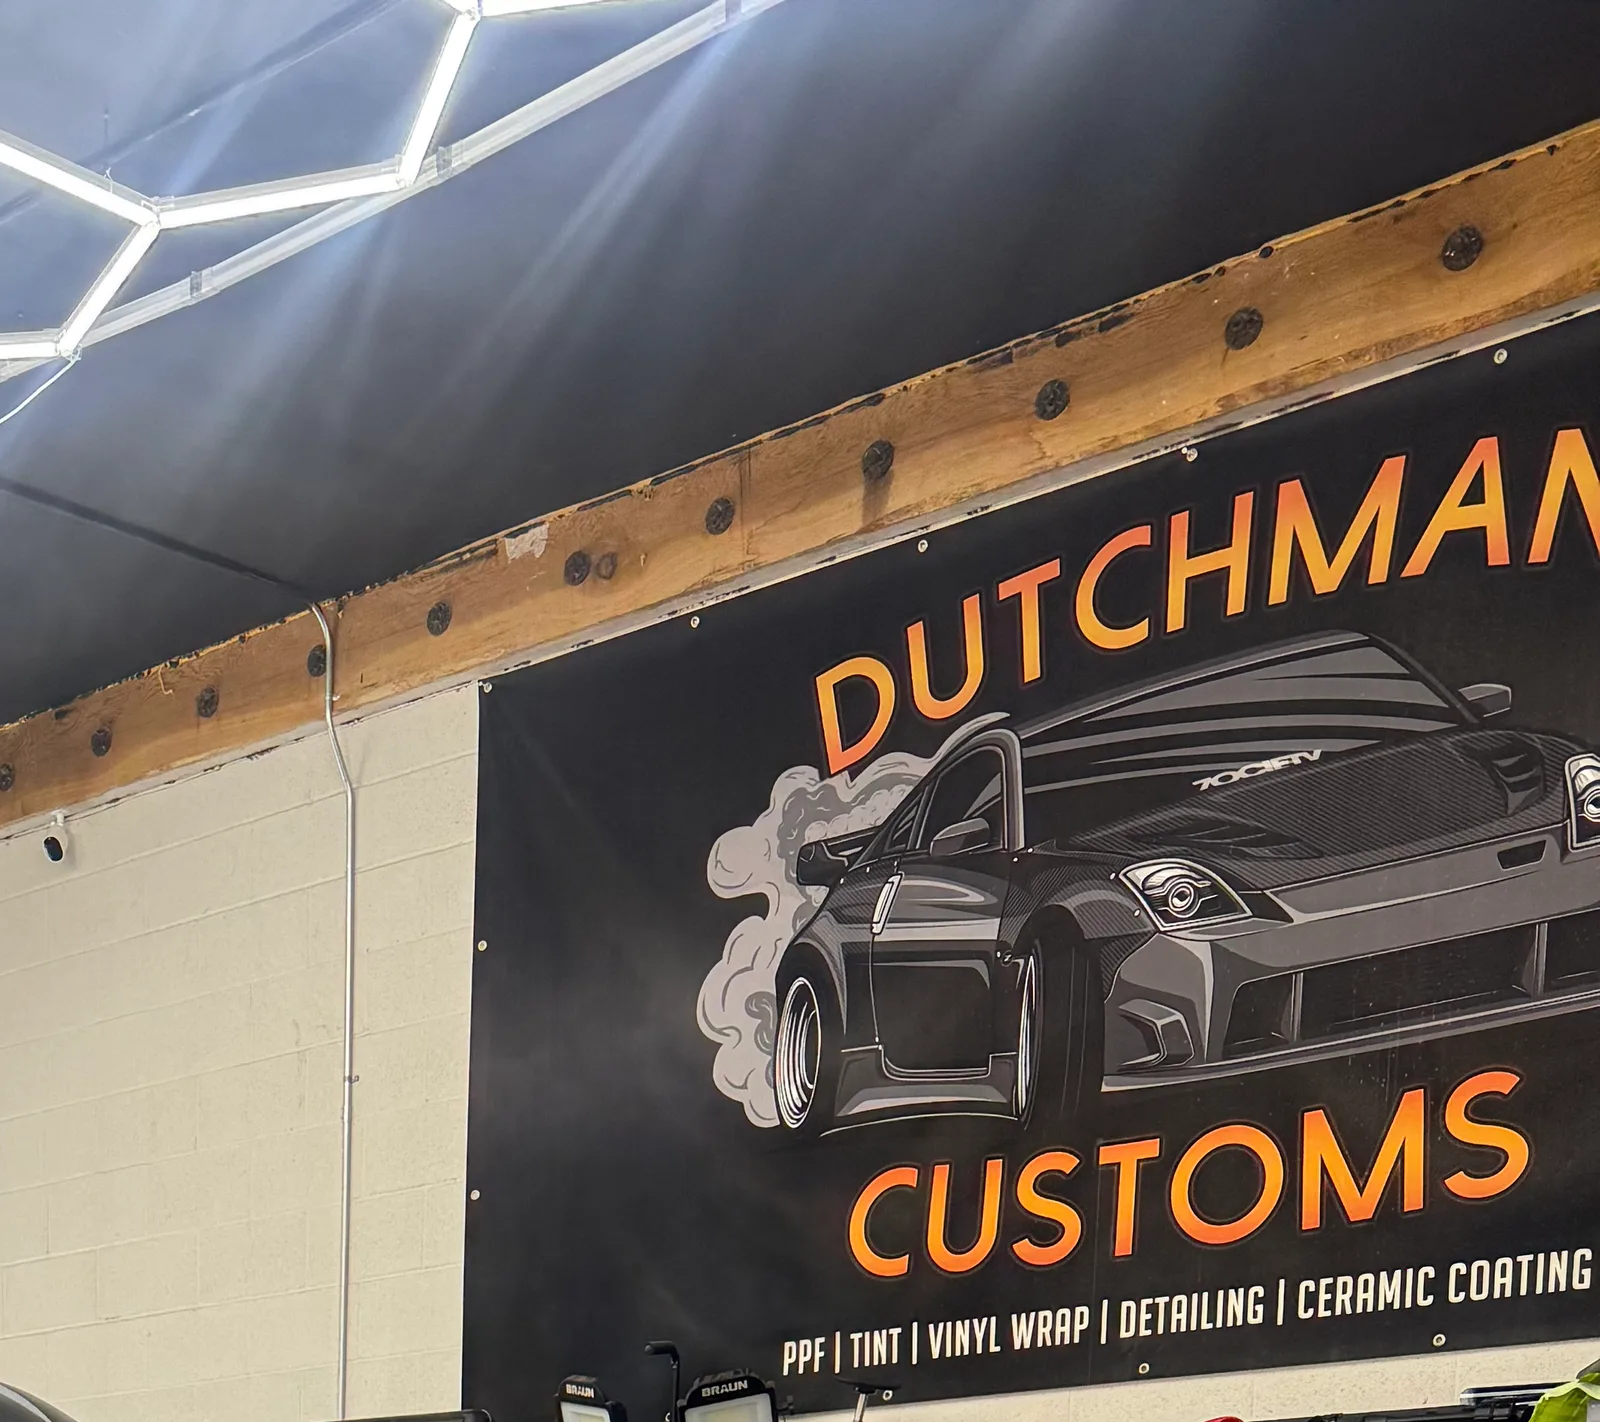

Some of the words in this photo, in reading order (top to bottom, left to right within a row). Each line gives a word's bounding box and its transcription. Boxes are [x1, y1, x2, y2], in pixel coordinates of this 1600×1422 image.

[813, 427, 1600, 777] DUTCHMAN
[846, 1069, 1532, 1279] CUSTOMS
[782, 1336, 827, 1376] PPF
[850, 1327, 902, 1369] TINT
[928, 1316, 1001, 1360] VINYL
[1011, 1305, 1090, 1351] WRAP
[1119, 1285, 1265, 1340] DETAILING
[1297, 1265, 1436, 1319] CERAMIC
[1448, 1247, 1592, 1304] COATING
[565, 1383, 595, 1399] BRAUN
[701, 1379, 749, 1398] BRAUN
